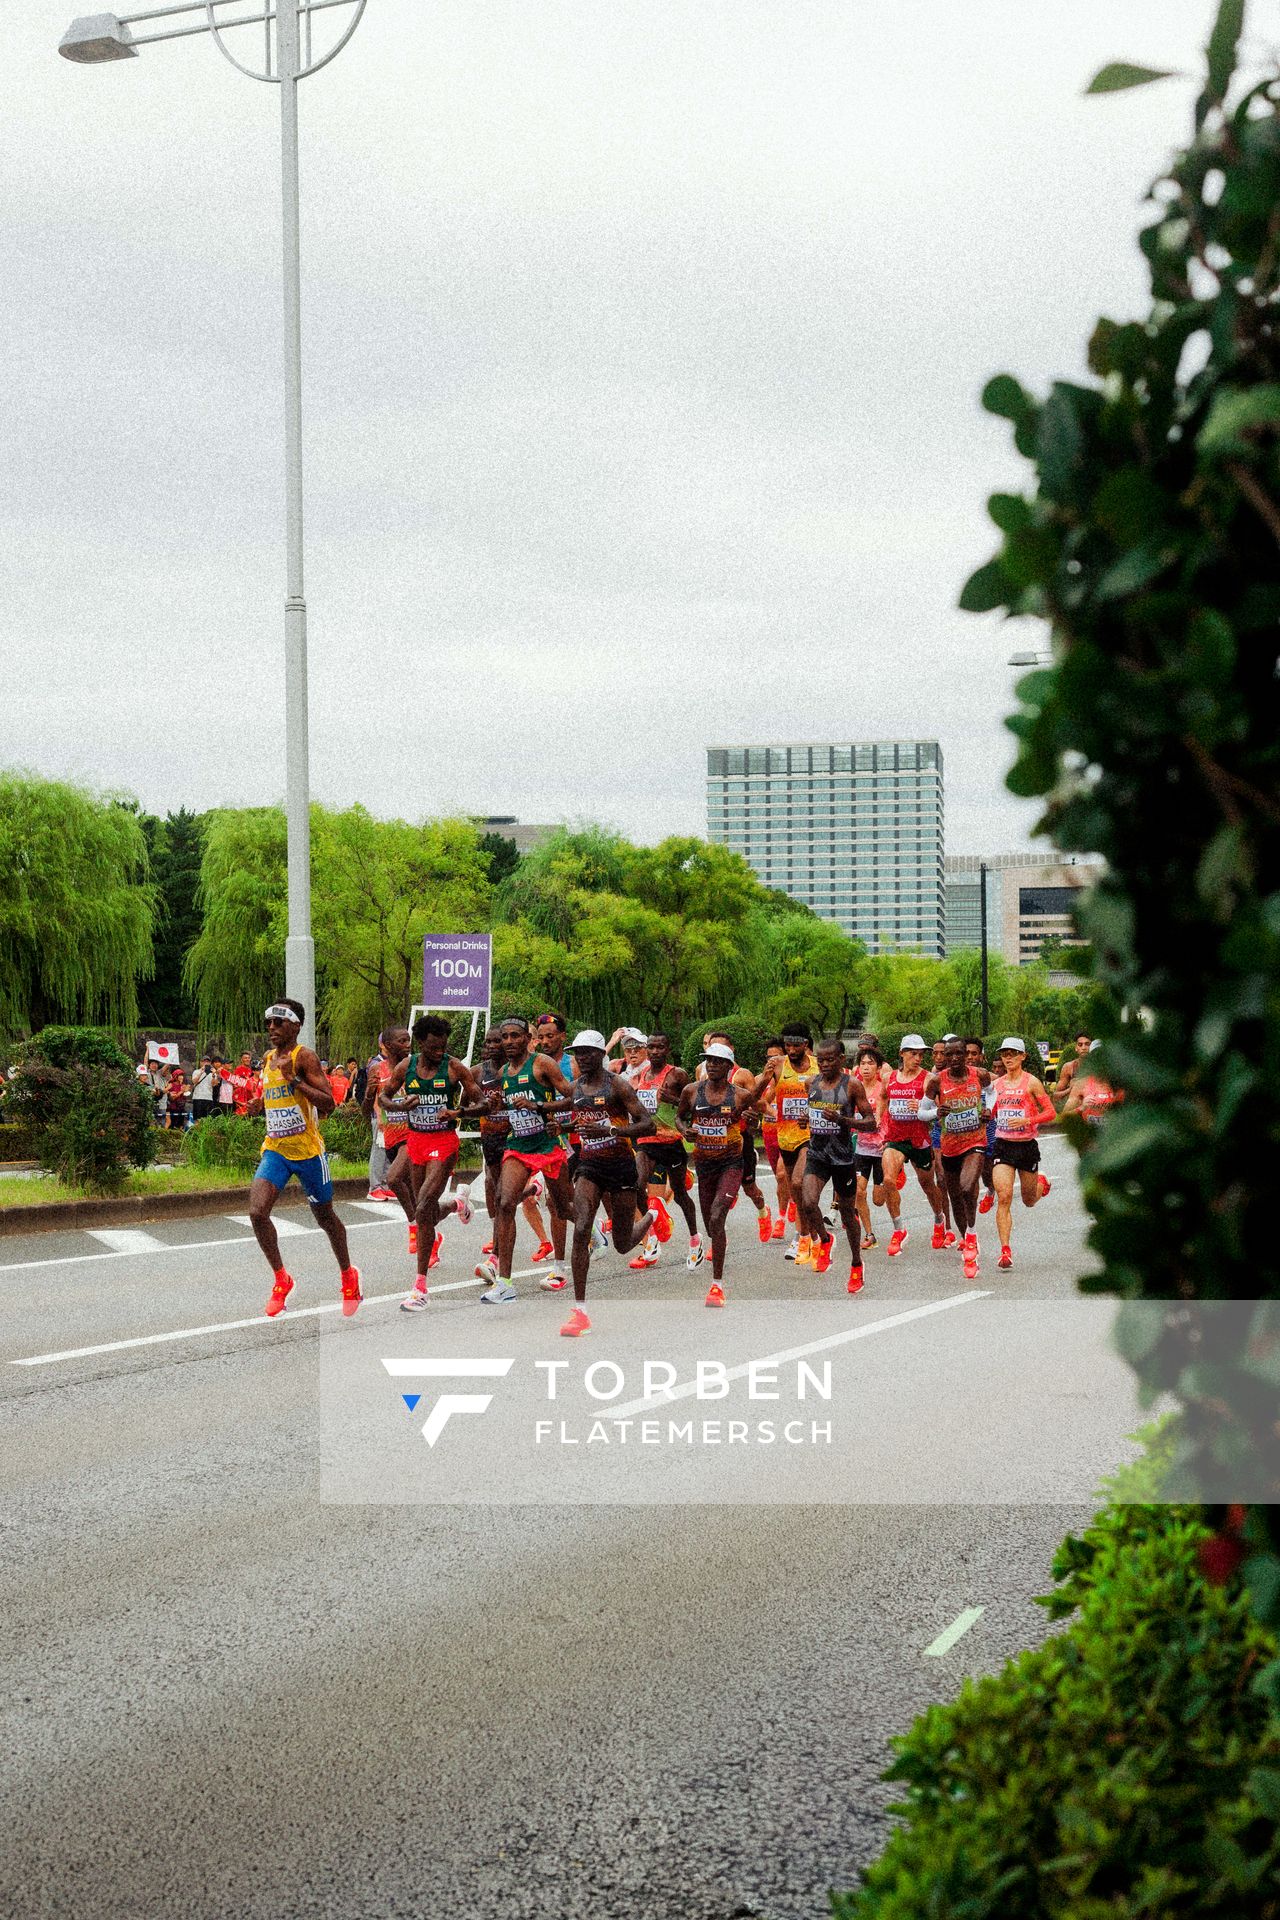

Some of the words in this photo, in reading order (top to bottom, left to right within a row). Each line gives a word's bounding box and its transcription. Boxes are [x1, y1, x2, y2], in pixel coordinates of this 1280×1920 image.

[426, 941, 460, 950] Personal
[462, 941, 488, 950] Drinks
[431, 959, 482, 978] 100M
[443, 986, 469, 996] ahead
[265, 1085, 295, 1100] WEDEN
[418, 1094, 449, 1105] HIOPIA
[945, 1096, 978, 1109] KENYA
[273, 1107, 299, 1118] TDK
[953, 1109, 975, 1120] TDK
[411, 1114, 441, 1124] TAKEL
[697, 1117, 732, 1126] UGANDA
[946, 1117, 978, 1129] NGETICH
[701, 1127, 724, 1136] TDK
